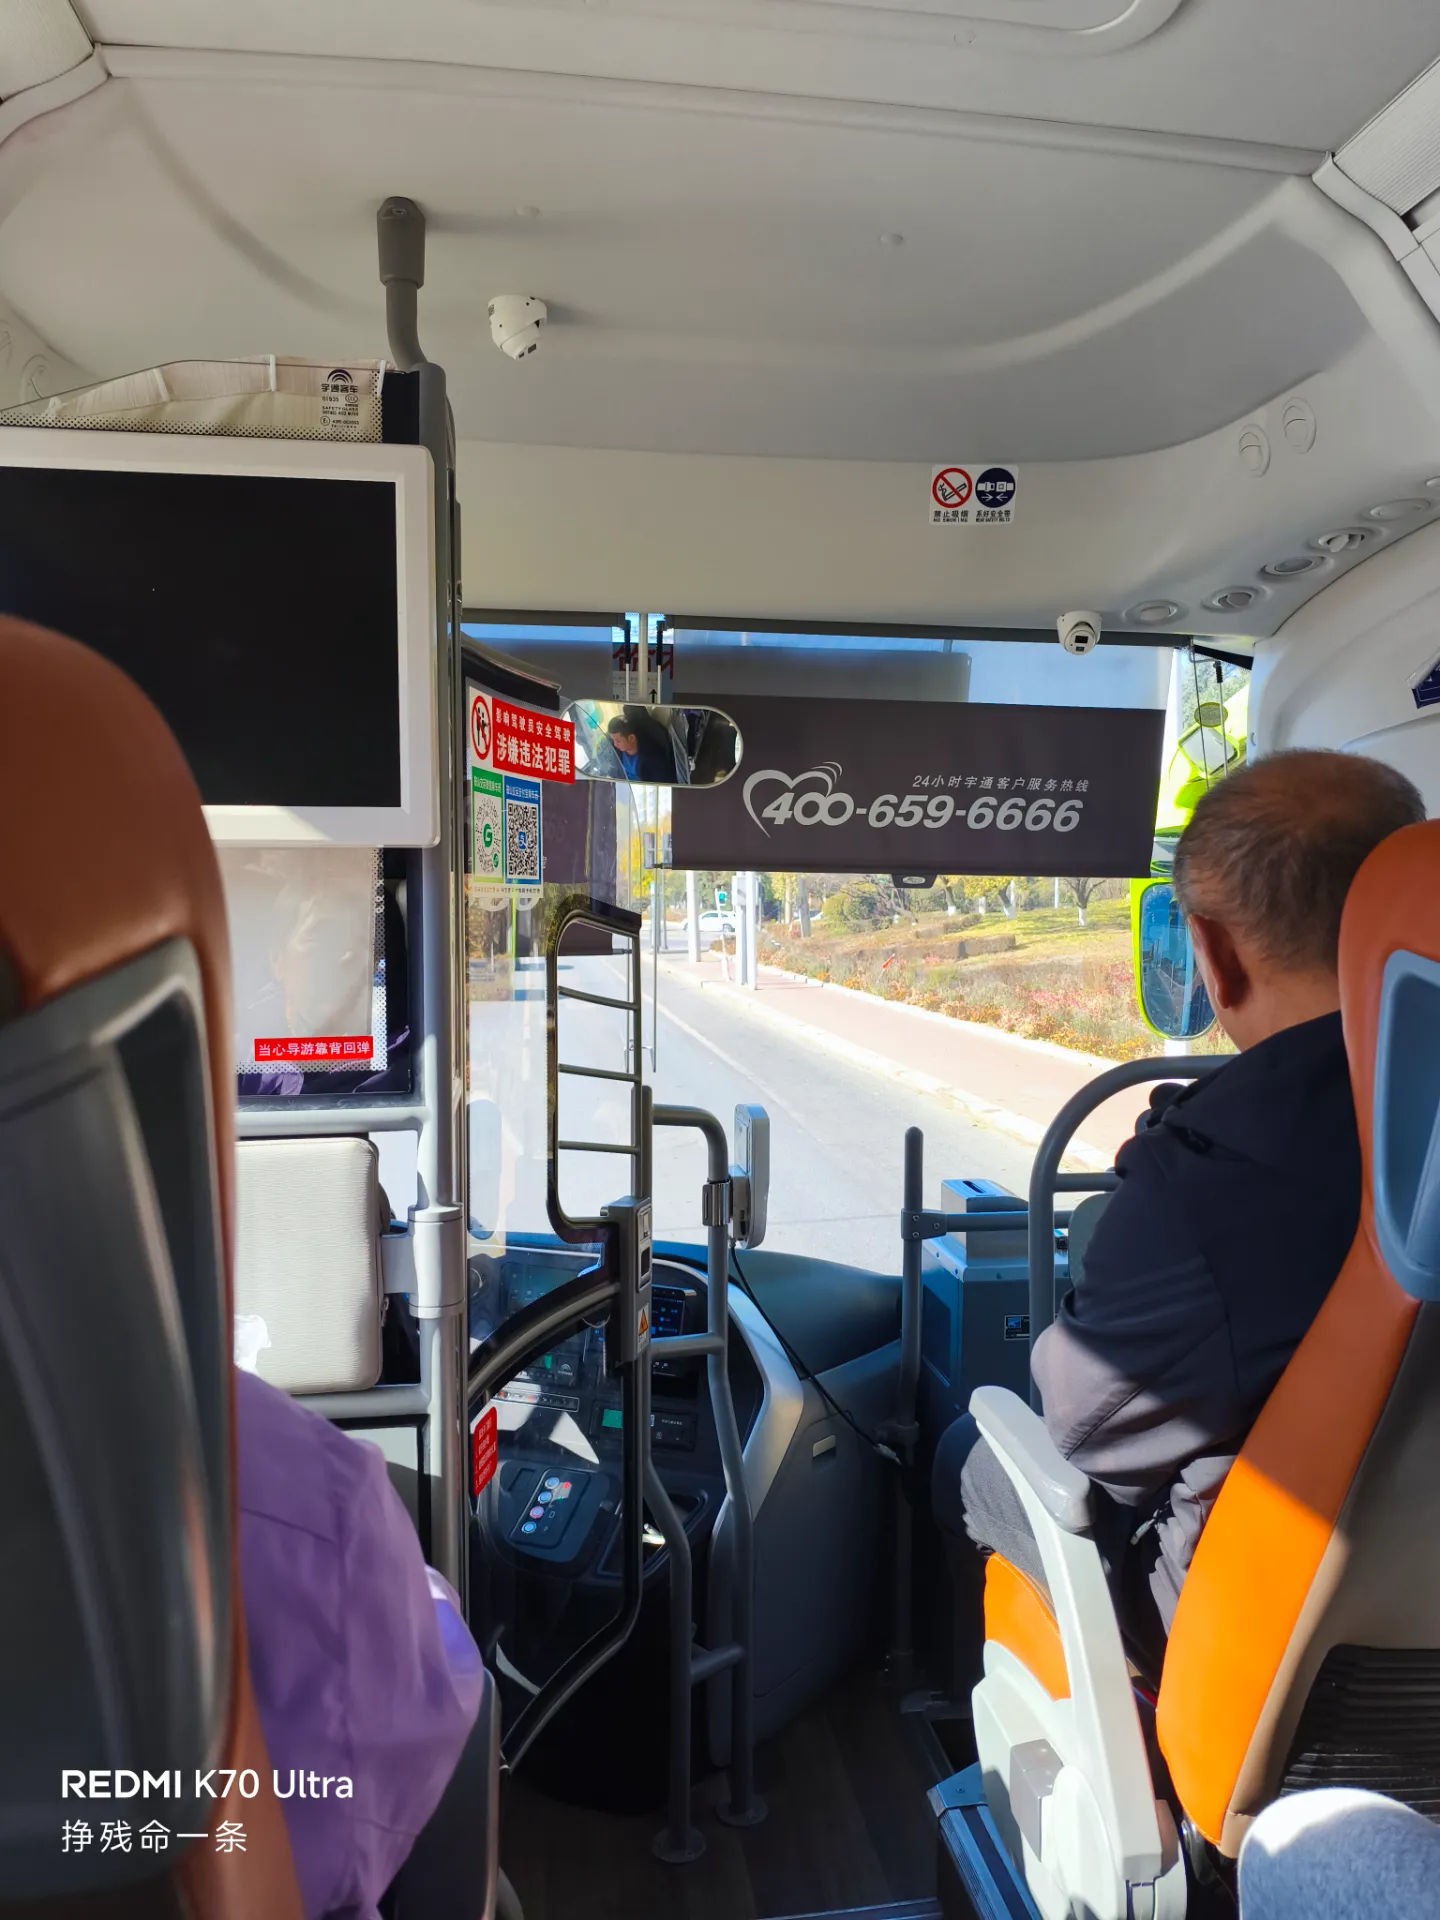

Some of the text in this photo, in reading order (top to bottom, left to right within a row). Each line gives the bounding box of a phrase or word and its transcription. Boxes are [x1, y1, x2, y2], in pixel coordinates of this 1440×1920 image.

[321, 384, 358, 393] 宇通客车
[496, 708, 571, 742] 影响驾驶员安全驾驶
[497, 732, 571, 775] 涉嫌违法犯罪
[912, 775, 1090, 792] 24小时宇通客户服务热线
[762, 791, 1084, 832] 400-659-6666
[259, 1041, 371, 1056] 当心导游靠背回弹
